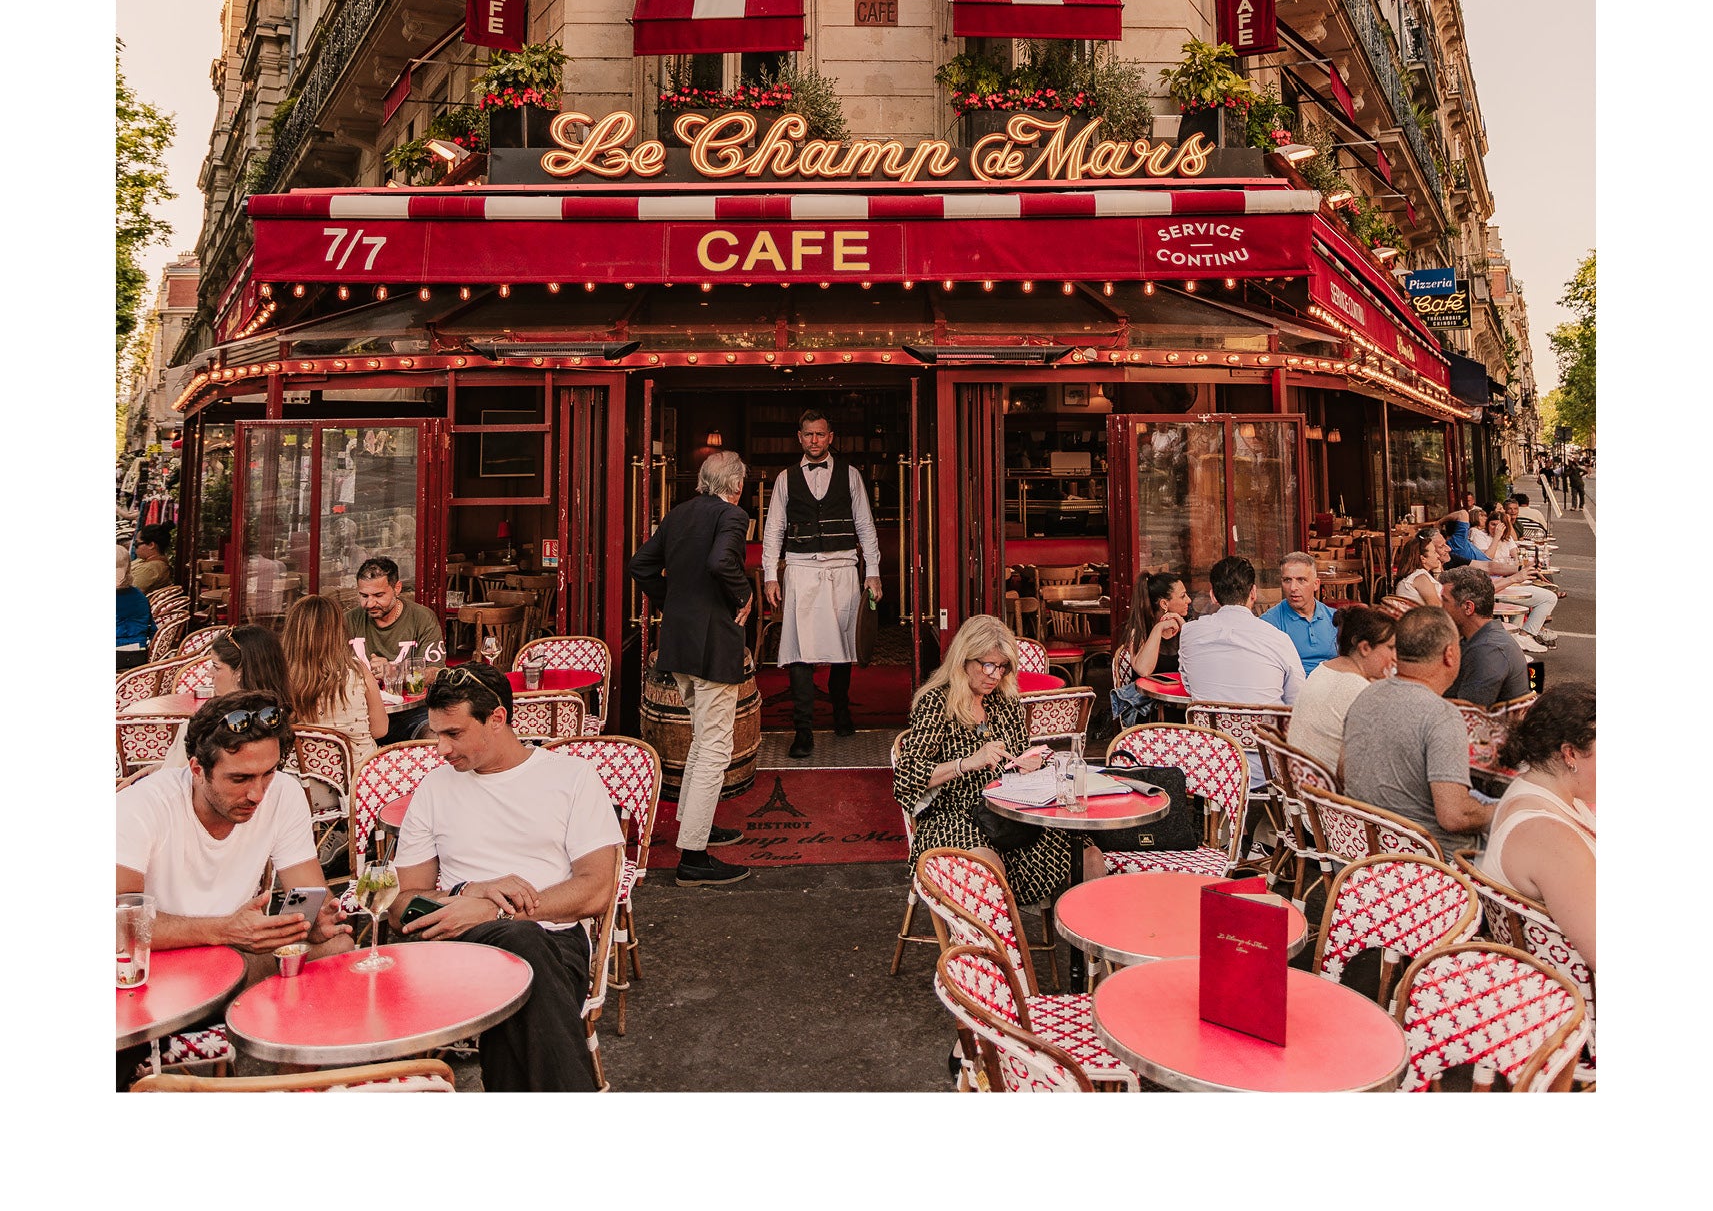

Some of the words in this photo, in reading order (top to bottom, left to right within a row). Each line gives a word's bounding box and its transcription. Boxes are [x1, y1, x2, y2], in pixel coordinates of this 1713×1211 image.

[857, 1, 896, 22] CAFE
[540, 110, 667, 178] Le
[673, 111, 959, 183] Champ
[970, 113, 1217, 182] Mars
[983, 141, 1025, 177] de
[1157, 222, 1244, 241] SERVICE
[323, 227, 387, 270] 7/7
[697, 230, 870, 272] CAFE
[1156, 247, 1249, 266] CONTINU
[1409, 277, 1453, 290] Pizzeria
[1412, 289, 1467, 313] Café
[746, 821, 812, 830] BISTROT
